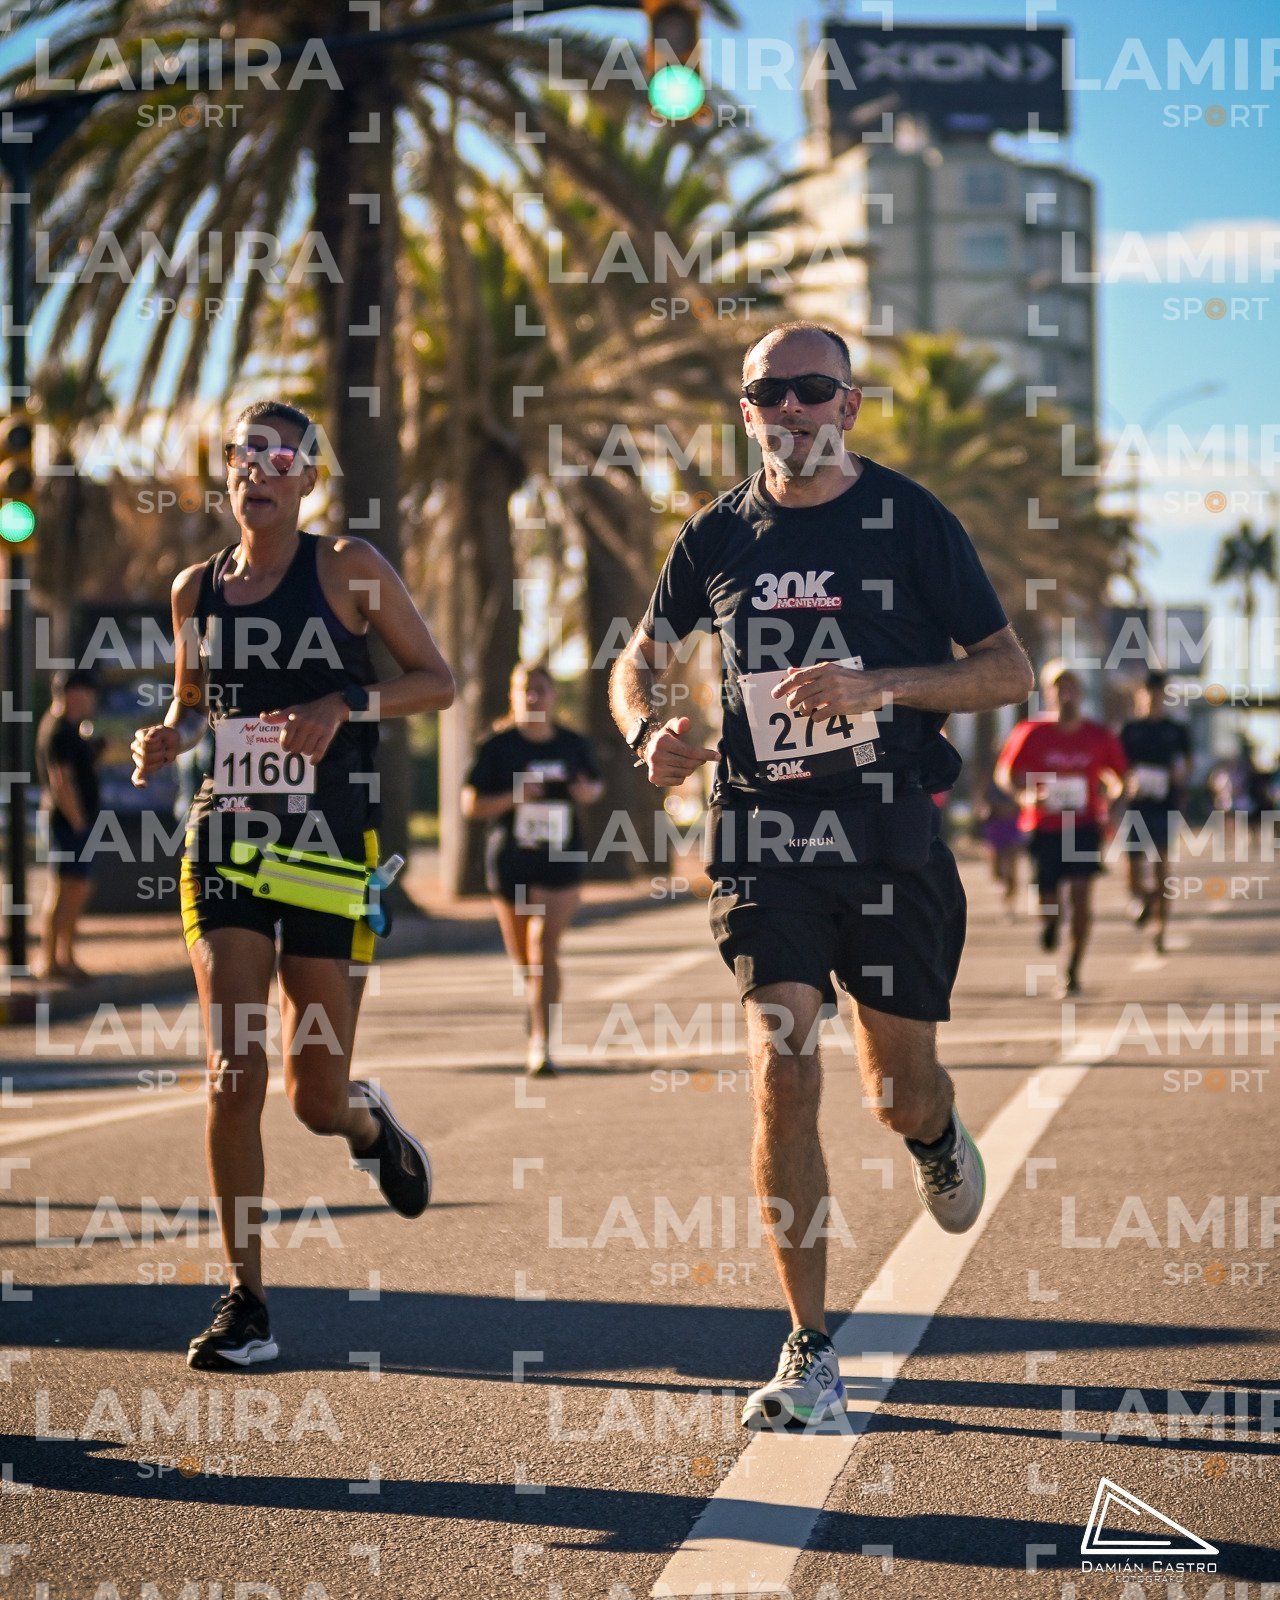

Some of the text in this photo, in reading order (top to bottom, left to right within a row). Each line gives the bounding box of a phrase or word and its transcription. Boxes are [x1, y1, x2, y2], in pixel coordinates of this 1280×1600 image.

[751, 570, 835, 611] 30K
[768, 708, 855, 752] 274
[222, 751, 305, 787] 1160
[766, 759, 805, 782] 30K
[788, 836, 834, 848] KIPRUN
